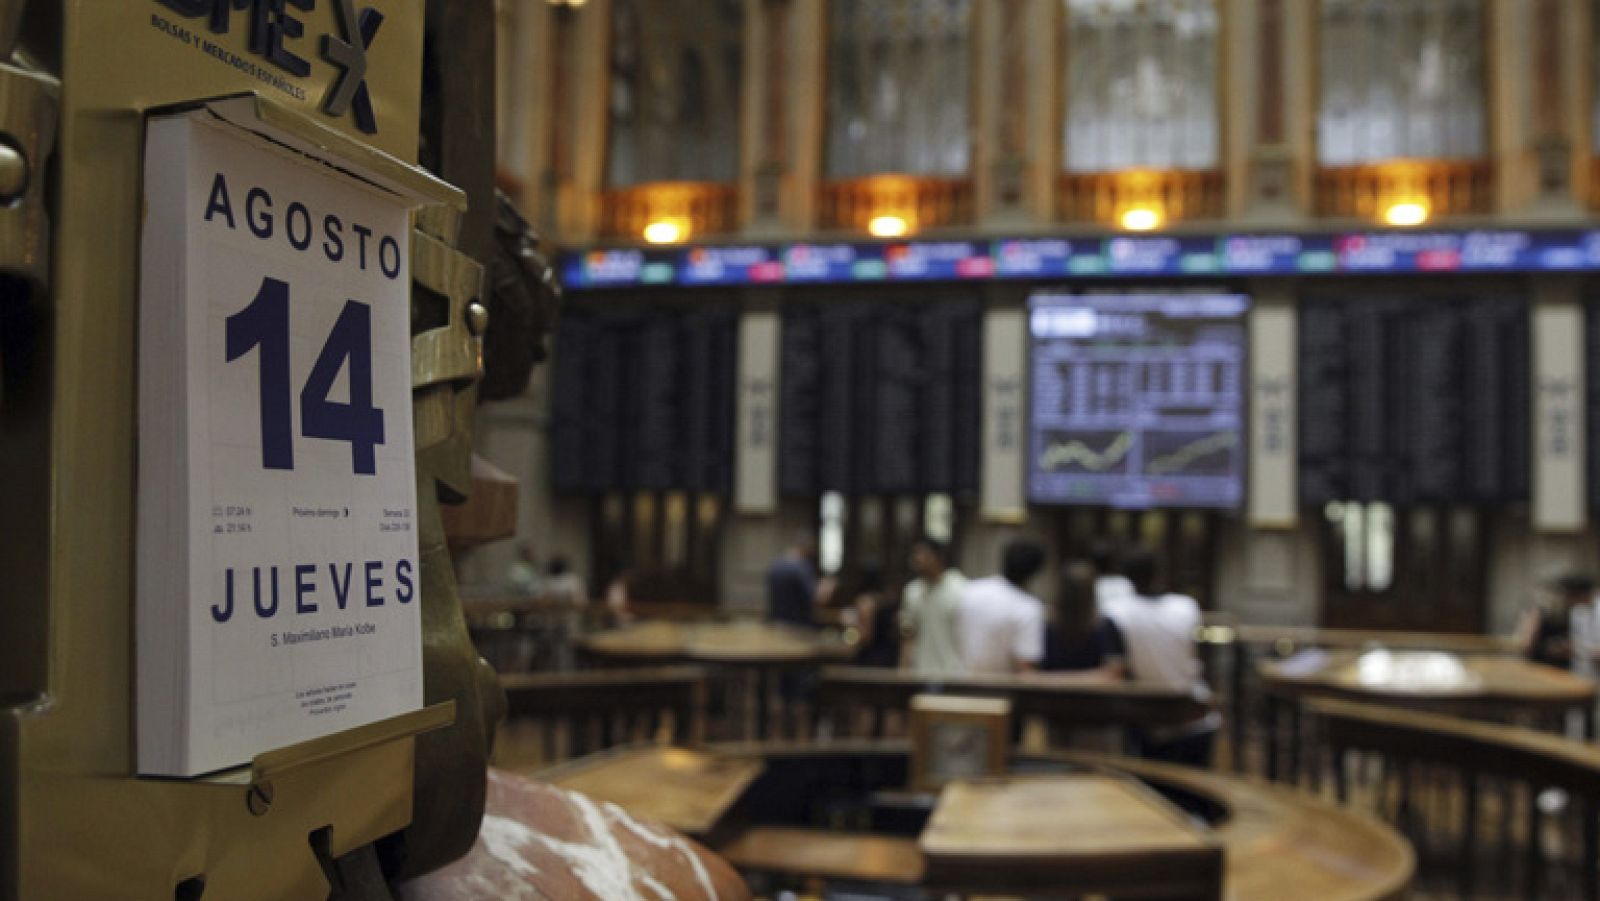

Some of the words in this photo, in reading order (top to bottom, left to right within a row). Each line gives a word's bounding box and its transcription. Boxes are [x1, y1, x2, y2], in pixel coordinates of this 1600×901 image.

[151, 13, 191, 44] BOLSAS
[193, 32, 201, 49] Y
[202, 39, 256, 76] MERCADOS
[204, 173, 401, 280] AGOSTO
[225, 276, 386, 476] 14
[211, 558, 414, 623] JUEVES
[283, 628, 330, 645] Maximiliano
